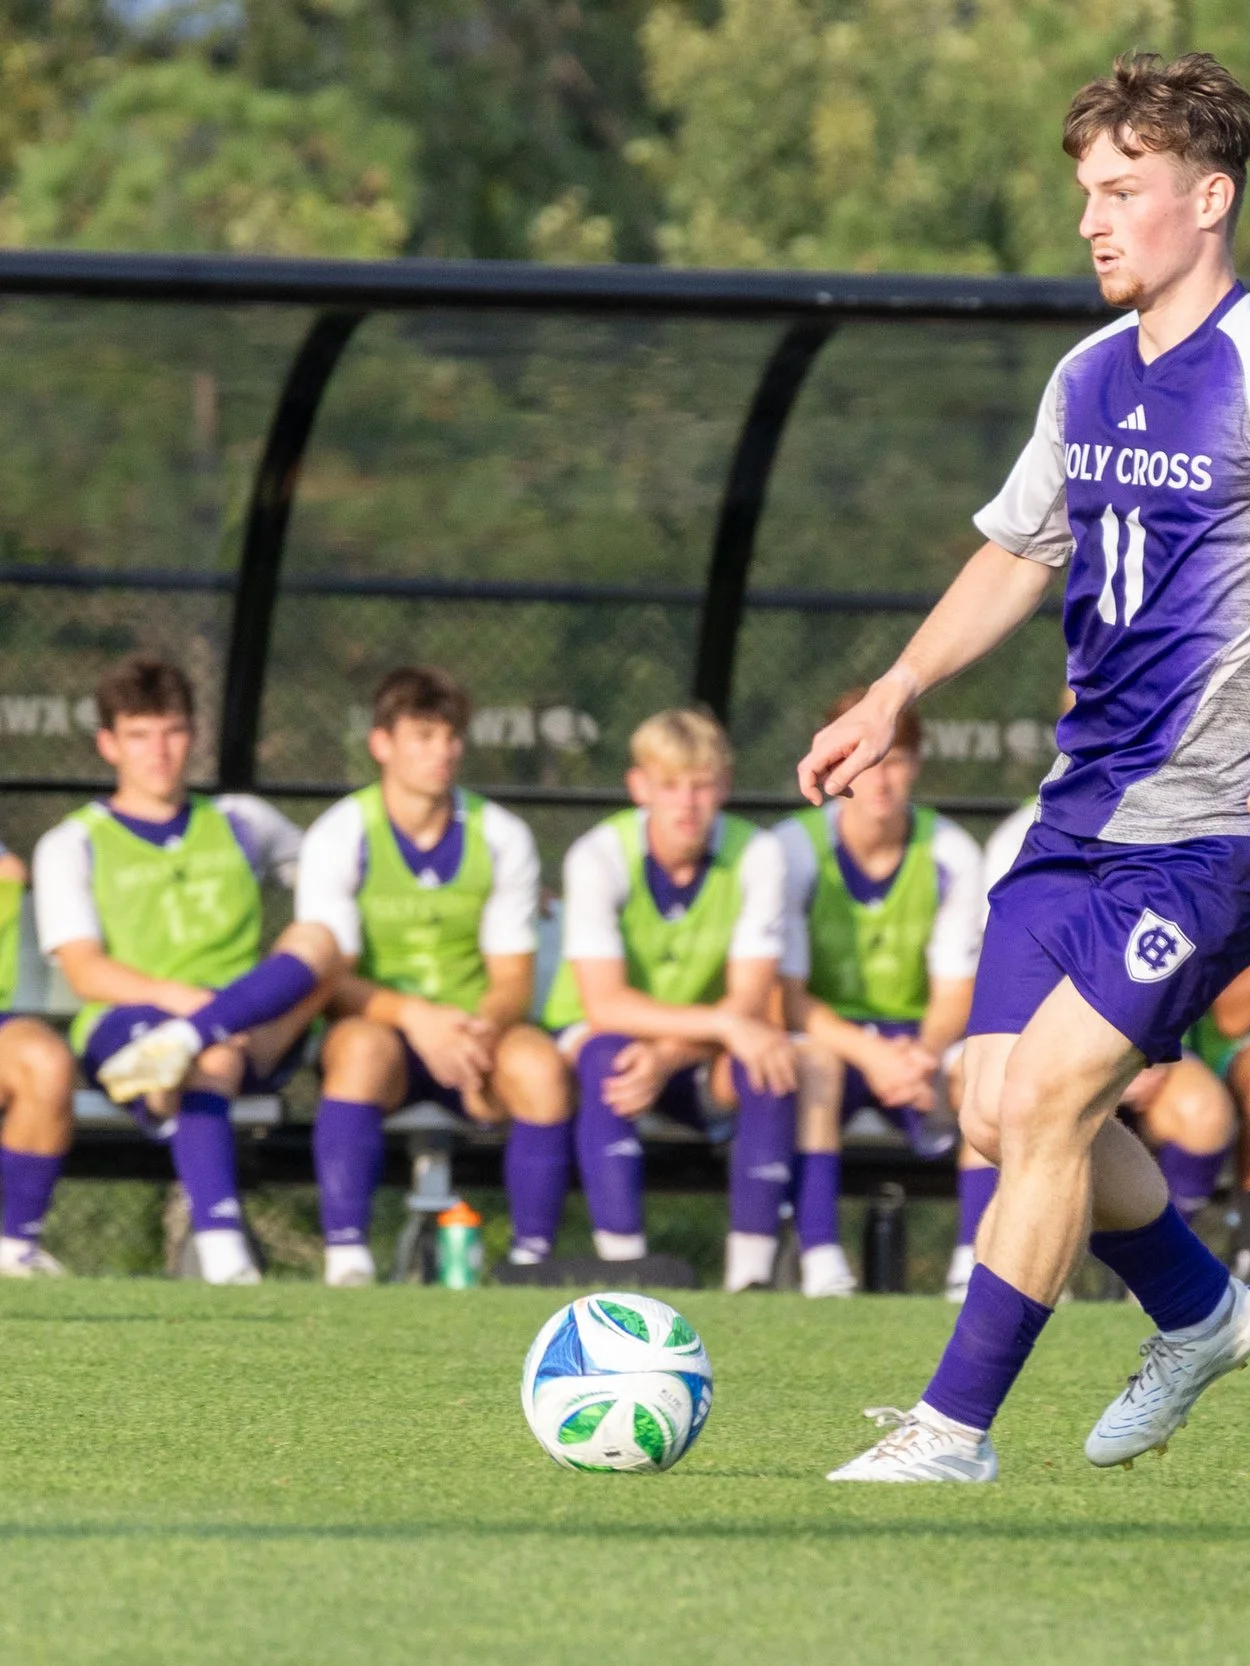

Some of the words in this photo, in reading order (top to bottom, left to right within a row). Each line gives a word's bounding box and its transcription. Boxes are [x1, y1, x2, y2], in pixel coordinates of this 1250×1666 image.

[1065, 443, 1113, 481] OLY
[1116, 447, 1213, 492] CROSS
[1097, 502, 1147, 627] 11
